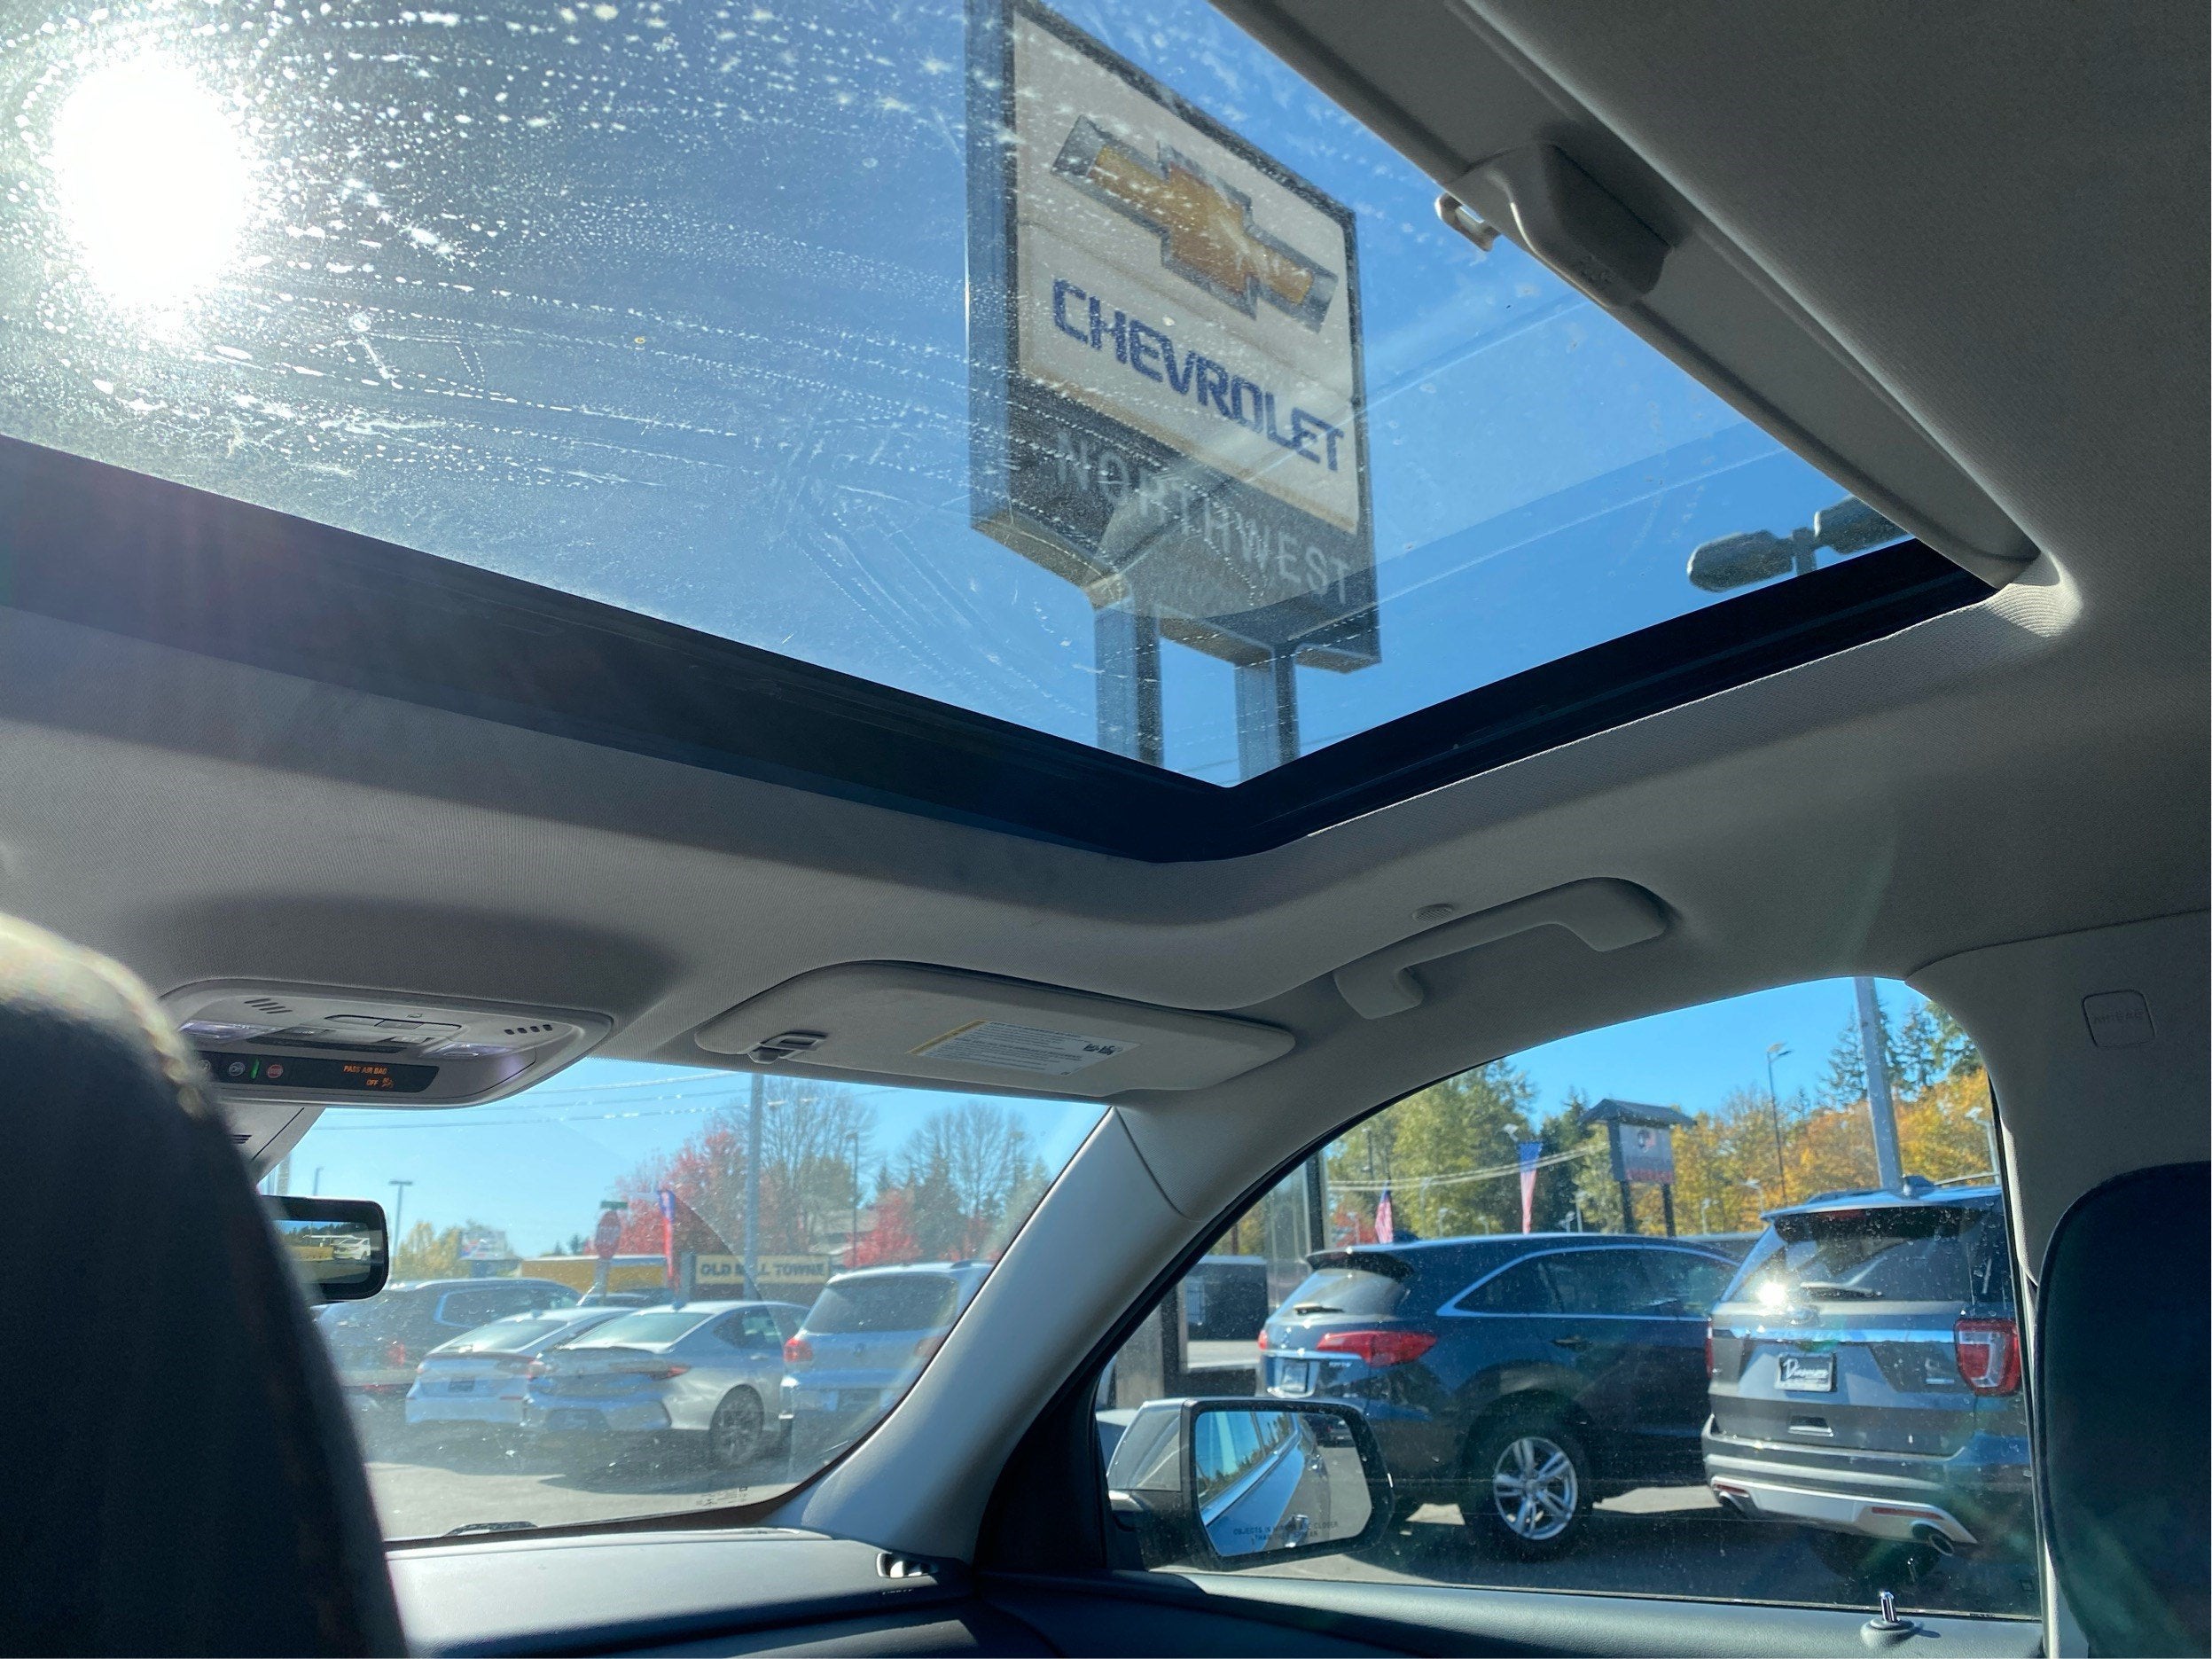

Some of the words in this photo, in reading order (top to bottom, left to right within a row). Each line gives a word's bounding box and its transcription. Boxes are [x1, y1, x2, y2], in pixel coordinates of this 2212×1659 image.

[1052, 279, 1344, 472] CHEVROLET
[1056, 429, 1352, 606] NORTHWEST
[343, 1065, 361, 1074] PASS
[700, 1264, 731, 1276] OLD
[1232, 1526, 1262, 1536] OBJECTS
